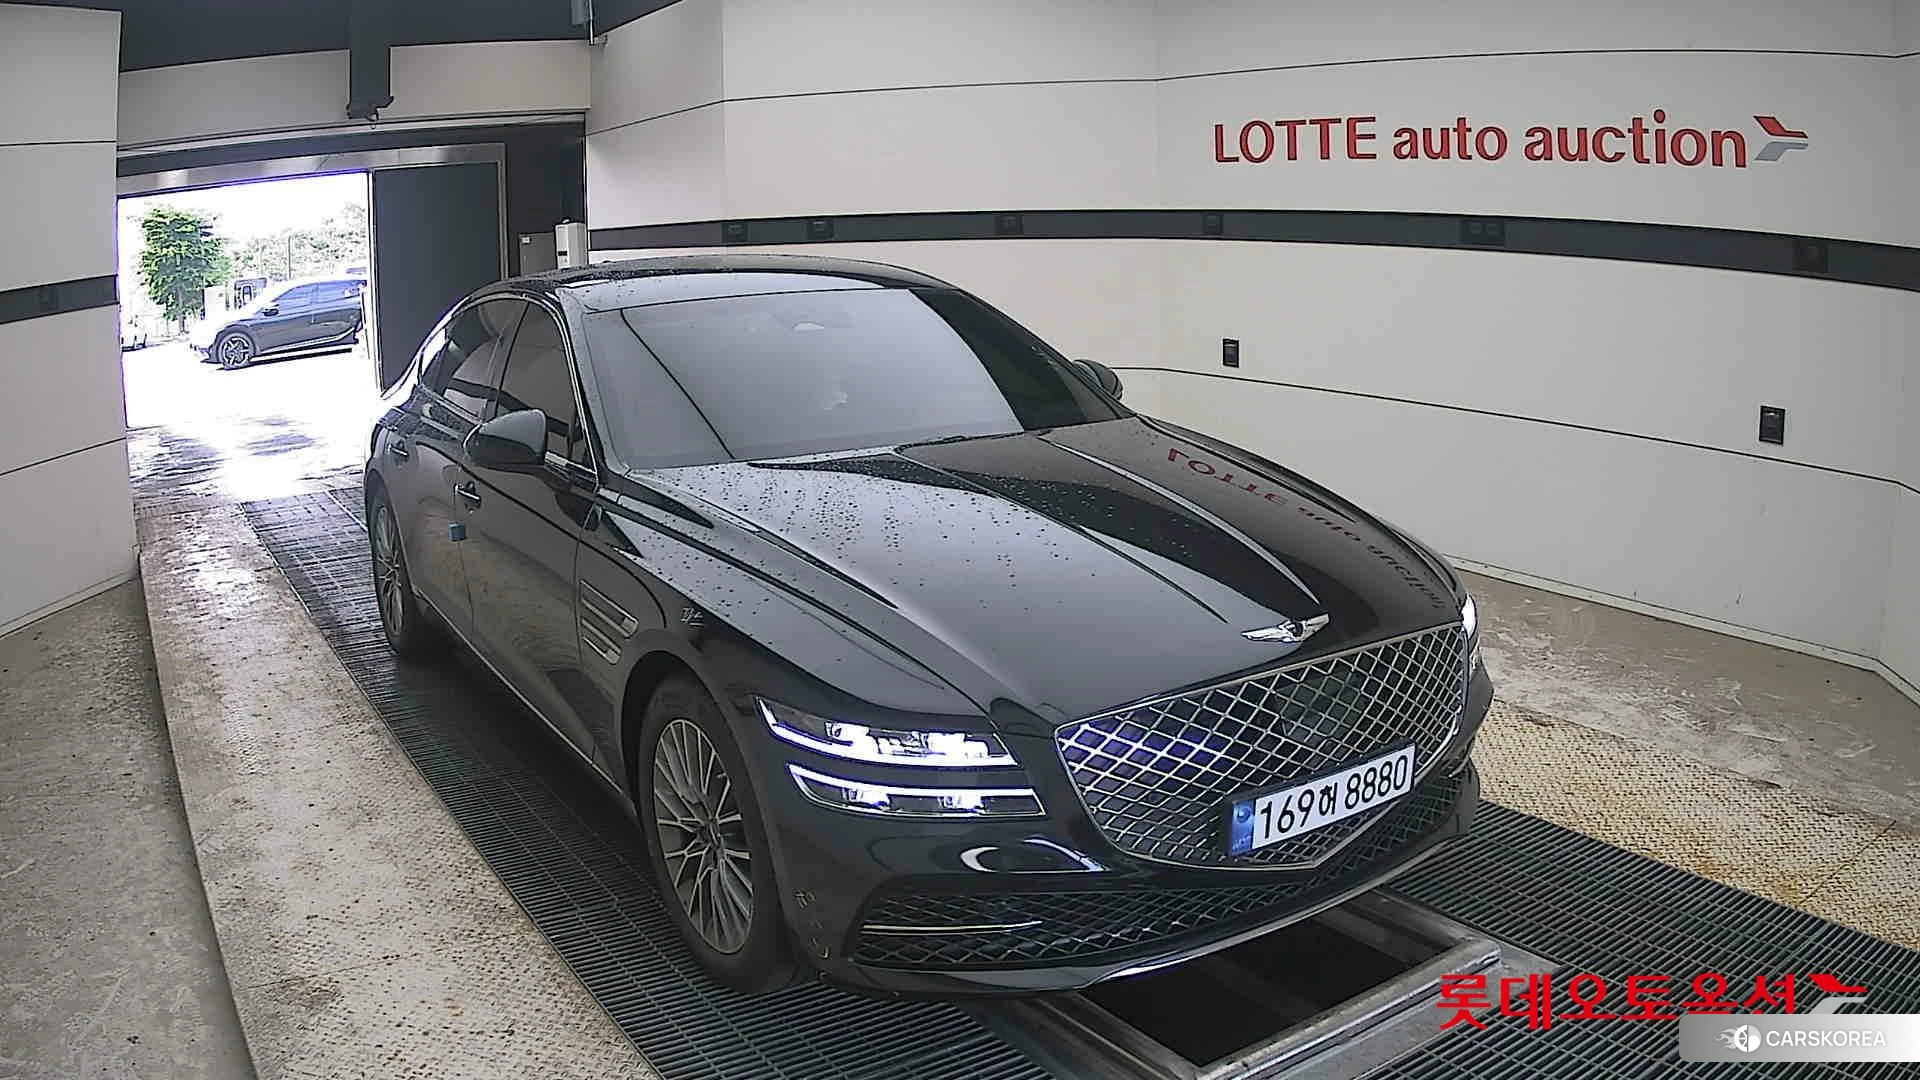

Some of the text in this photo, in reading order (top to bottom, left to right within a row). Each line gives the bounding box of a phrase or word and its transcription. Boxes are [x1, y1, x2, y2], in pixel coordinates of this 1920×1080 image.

[1214, 109, 1748, 168] LOTTE auto auction
[1260, 754, 1408, 839] 169허 8880
